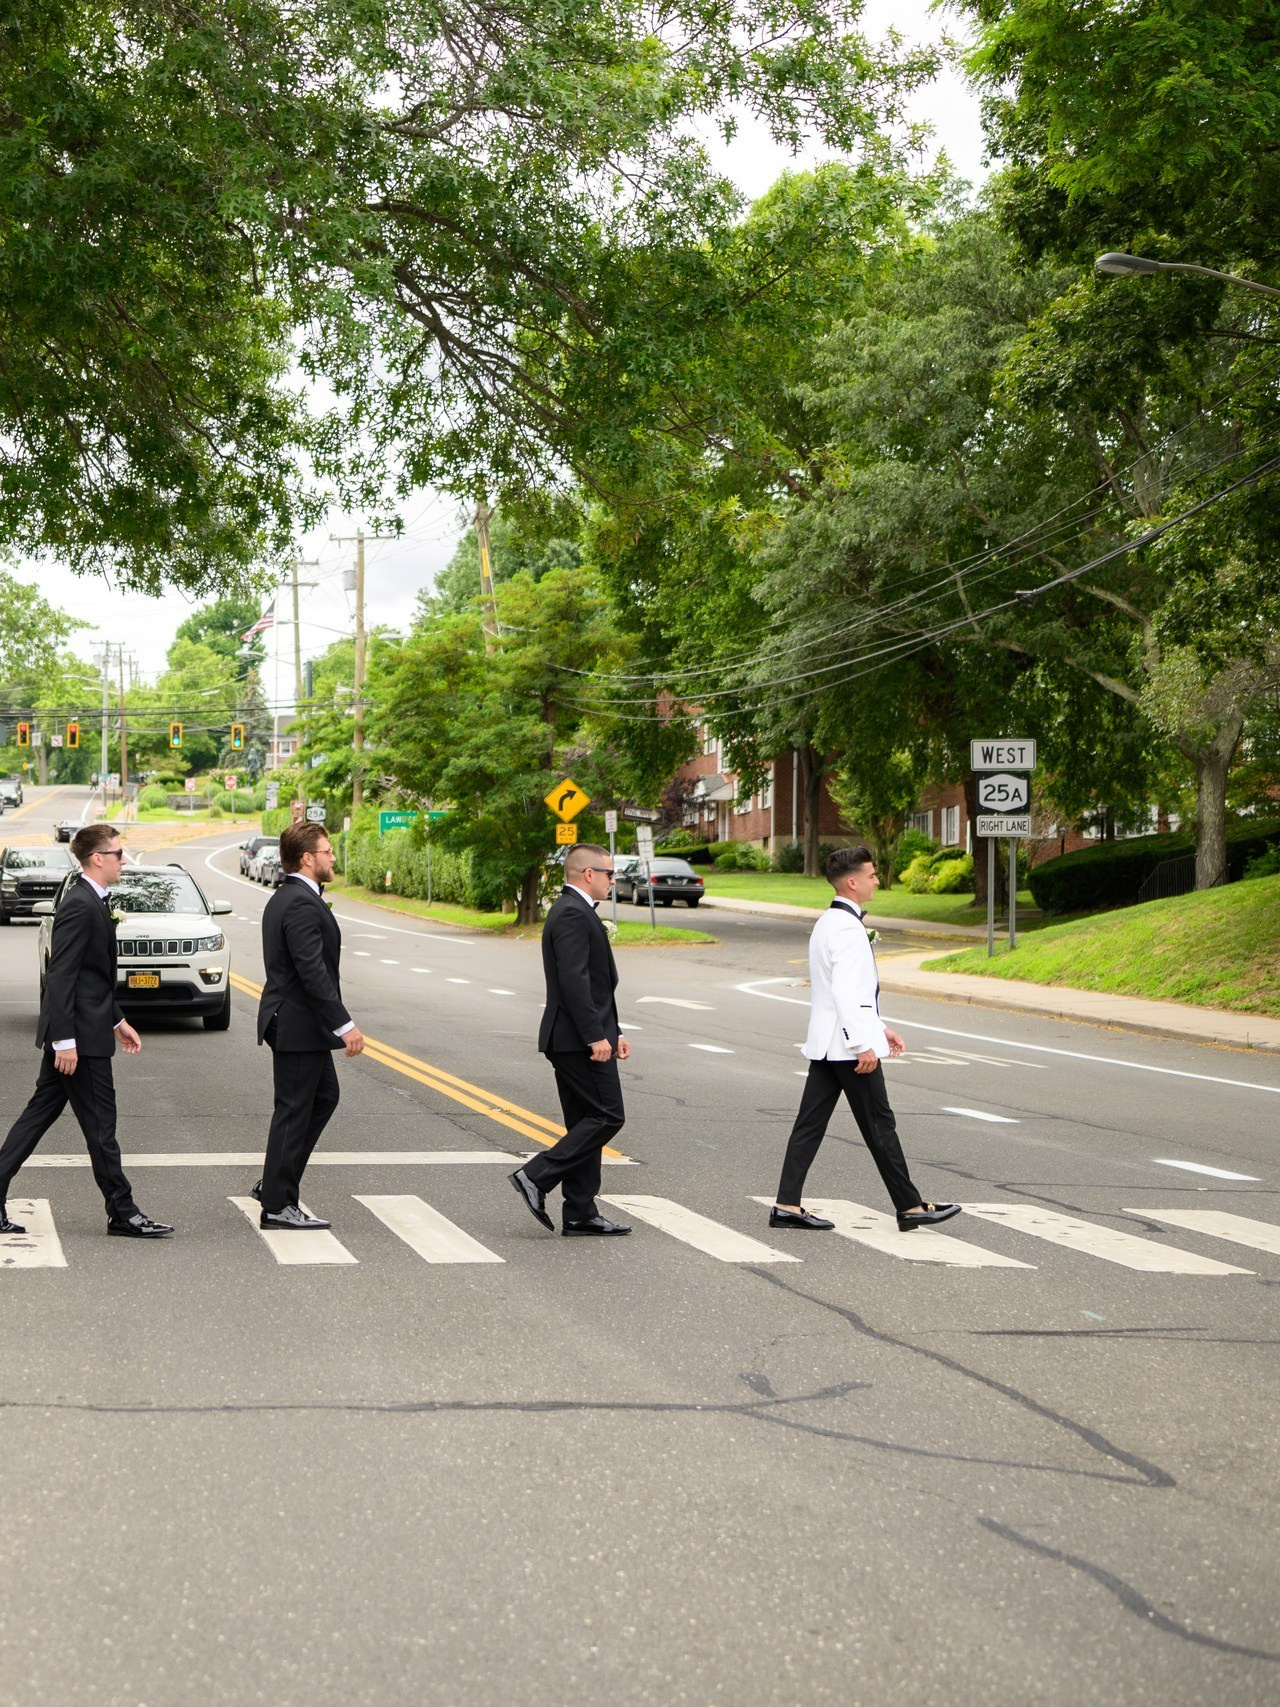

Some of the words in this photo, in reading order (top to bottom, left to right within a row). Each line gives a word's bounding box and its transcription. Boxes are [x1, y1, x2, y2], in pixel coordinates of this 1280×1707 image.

[981, 746, 1026, 764] WEST
[983, 784, 1023, 802] 25A
[307, 810, 325, 818] 25A
[558, 826, 575, 836] 25
[980, 820, 1005, 832] RIGHT
[1006, 820, 1028, 832] LANE
